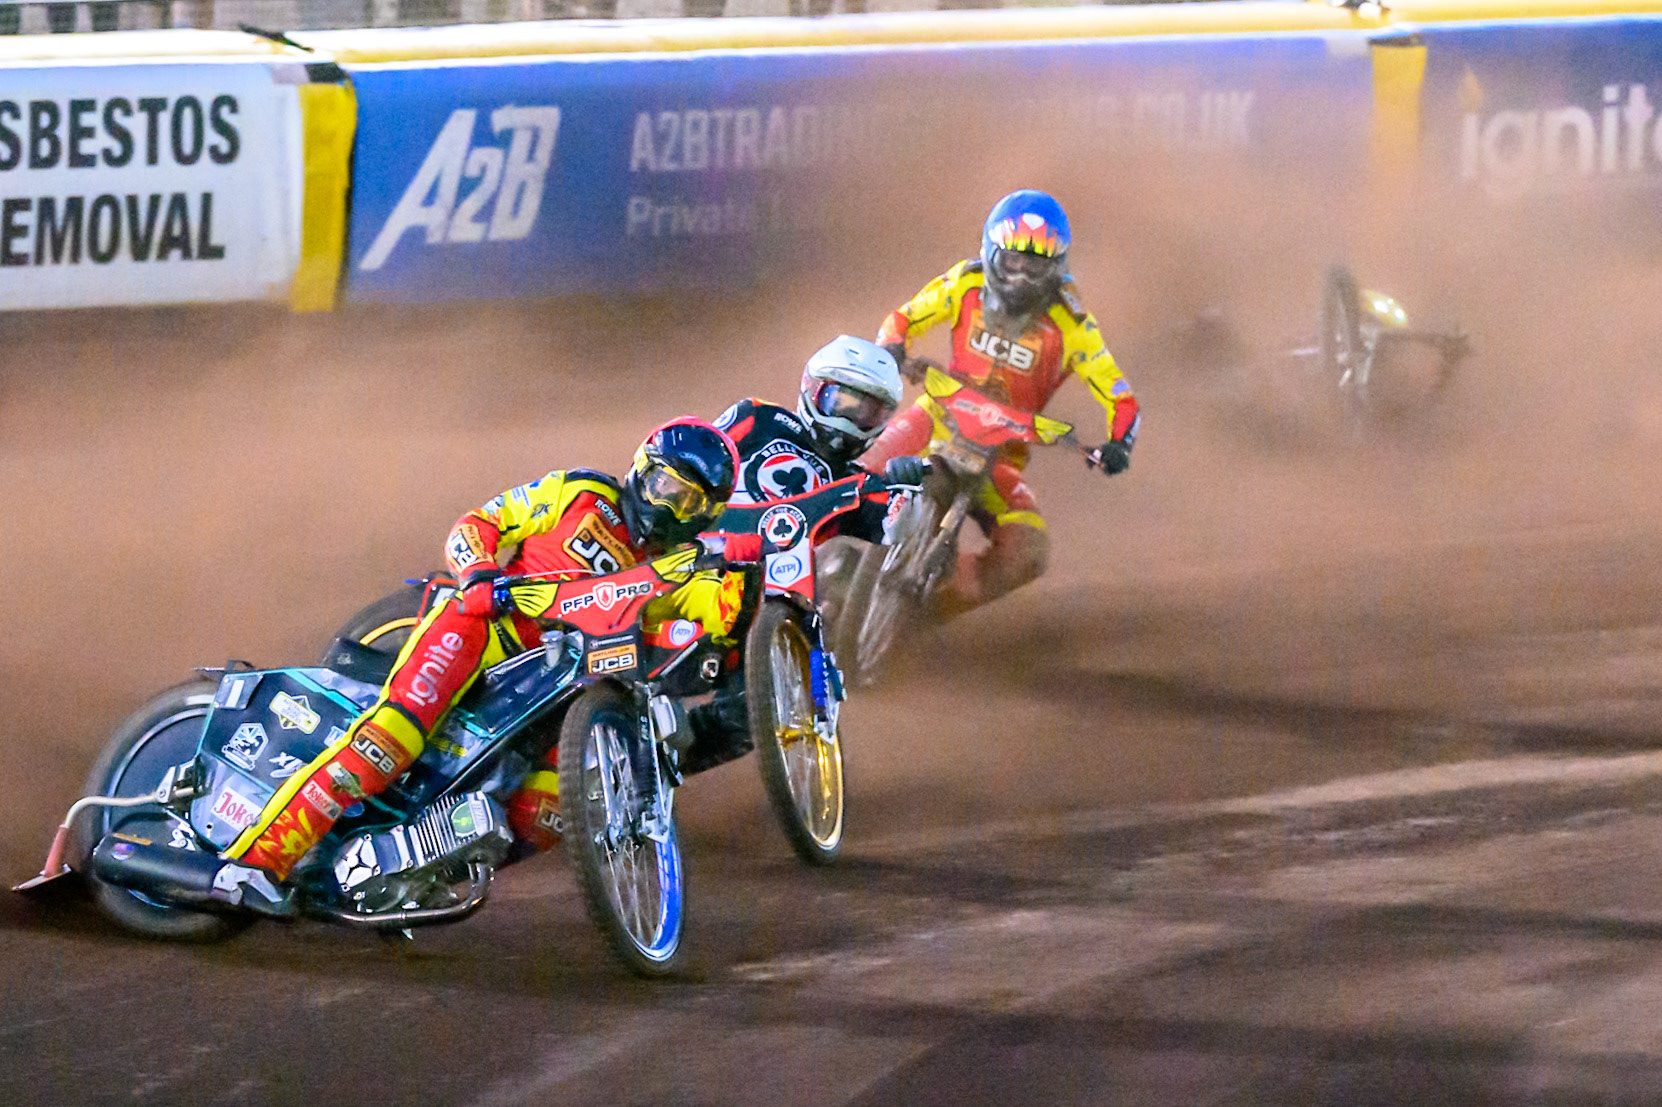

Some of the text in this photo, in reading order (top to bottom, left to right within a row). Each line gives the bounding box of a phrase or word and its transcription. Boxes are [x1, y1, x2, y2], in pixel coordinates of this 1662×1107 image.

[359, 105, 561, 272] A2B
[970, 331, 1035, 370] JCB
[594, 498, 622, 527] ROWE
[774, 562, 797, 575] ATPI
[562, 581, 653, 613] PFP PRO
[592, 653, 634, 673] JCB
[353, 739, 396, 773] JCB
[213, 791, 255, 827] Joke
